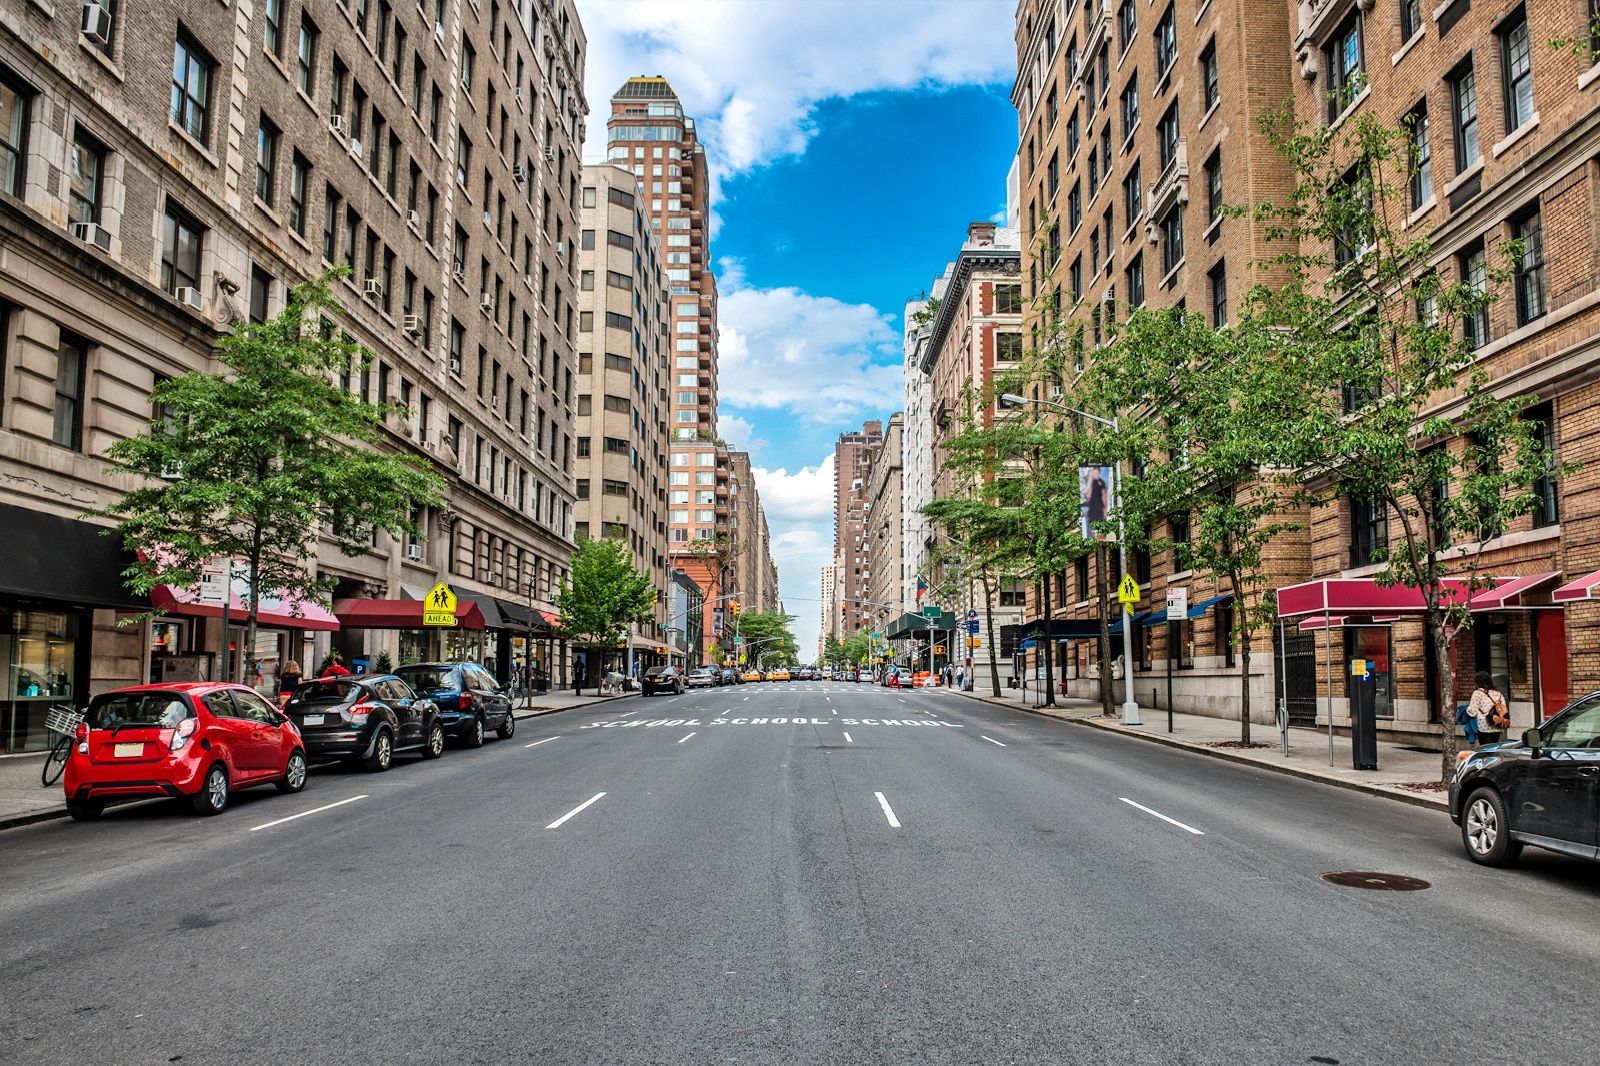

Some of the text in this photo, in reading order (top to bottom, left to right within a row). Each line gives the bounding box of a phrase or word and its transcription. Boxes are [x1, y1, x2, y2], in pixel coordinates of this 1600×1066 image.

[357, 665, 363, 674] P
[580, 717, 965, 729] SCHOOL SCHOOL SCHOOL
